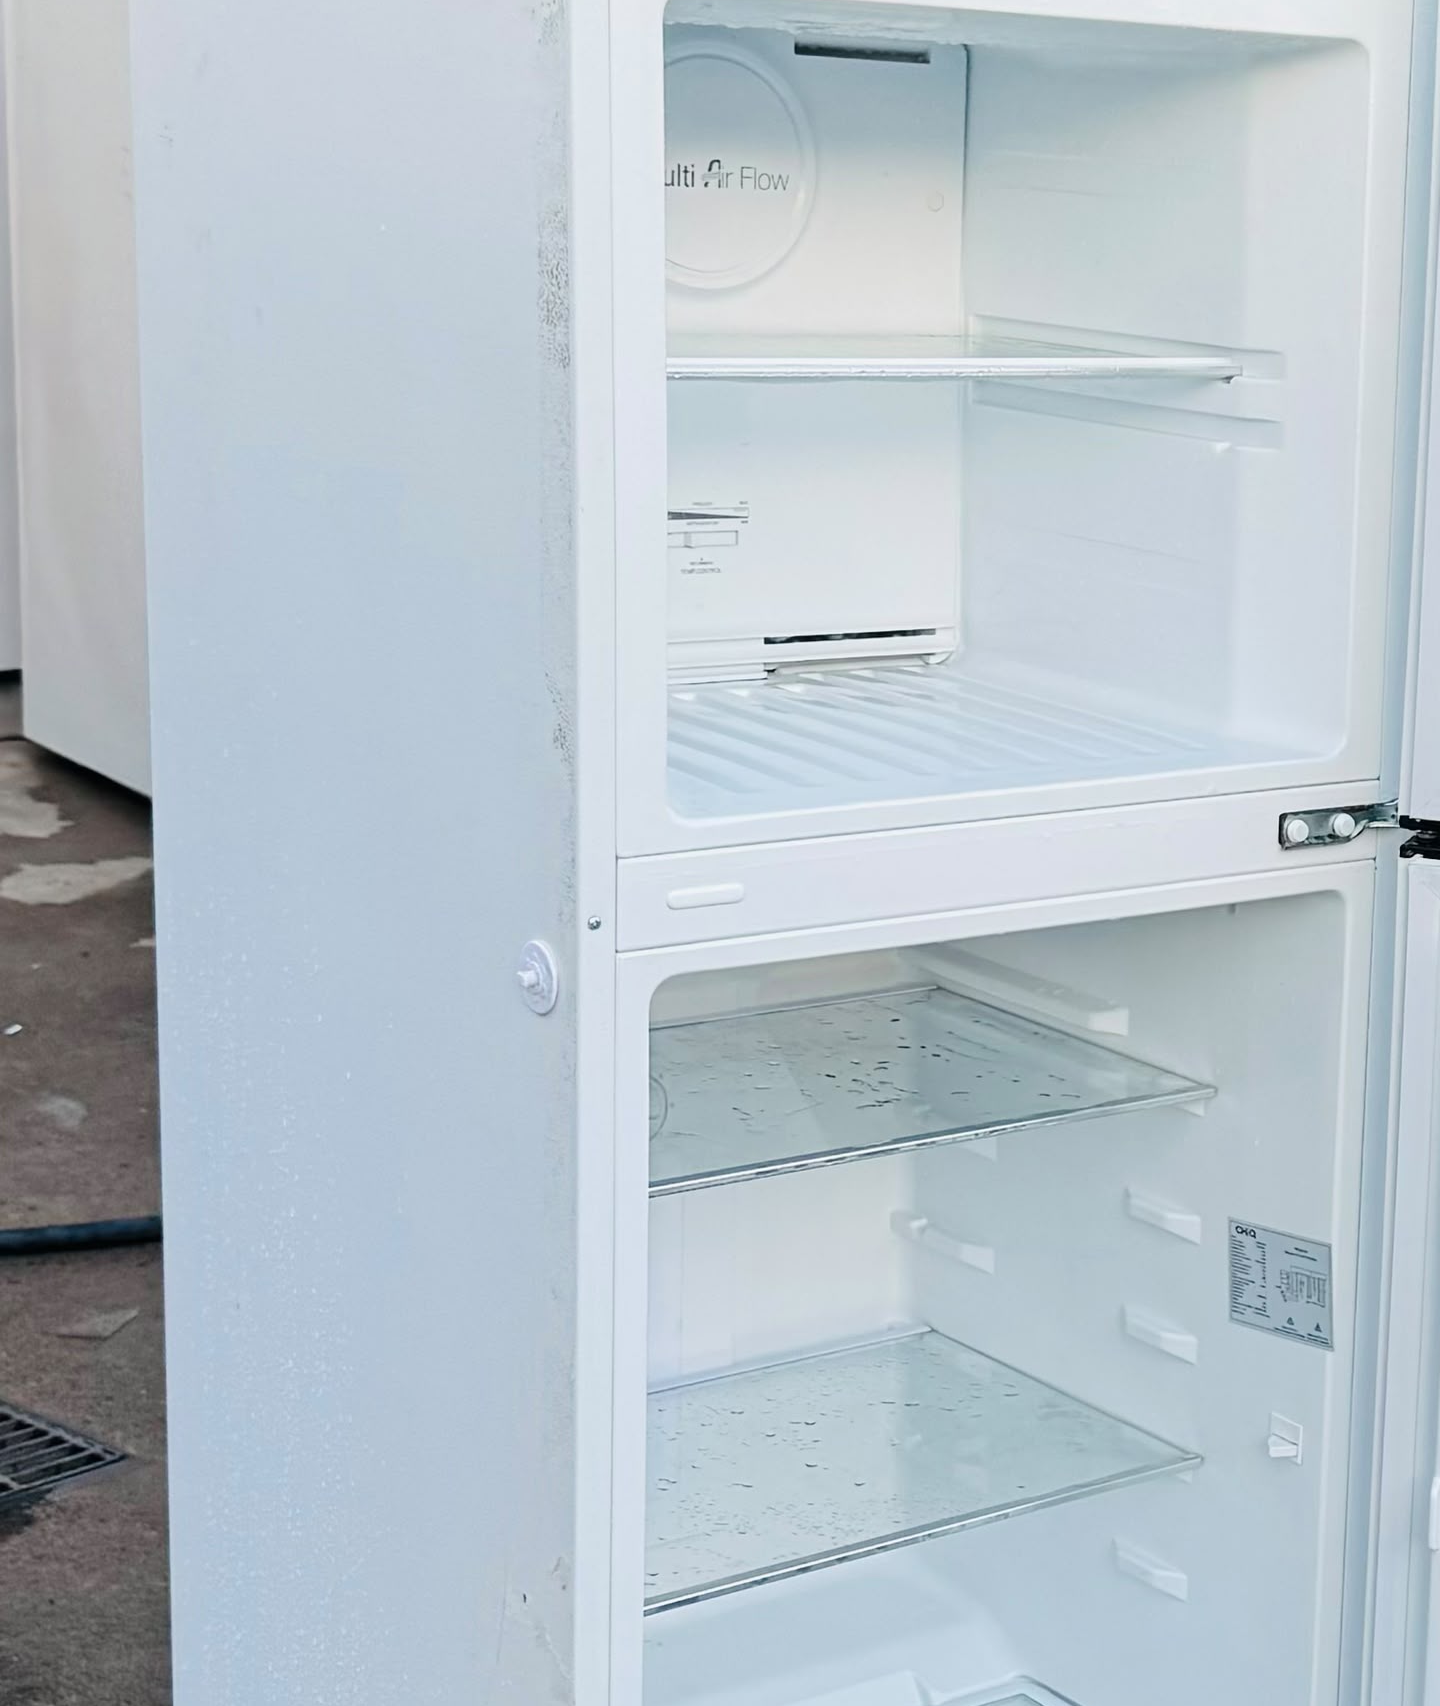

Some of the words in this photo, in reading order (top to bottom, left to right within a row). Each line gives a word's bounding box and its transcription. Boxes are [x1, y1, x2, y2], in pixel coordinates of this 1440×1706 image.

[664, 162, 695, 188] ulti
[701, 159, 734, 189] Air
[739, 166, 790, 191] Flow
